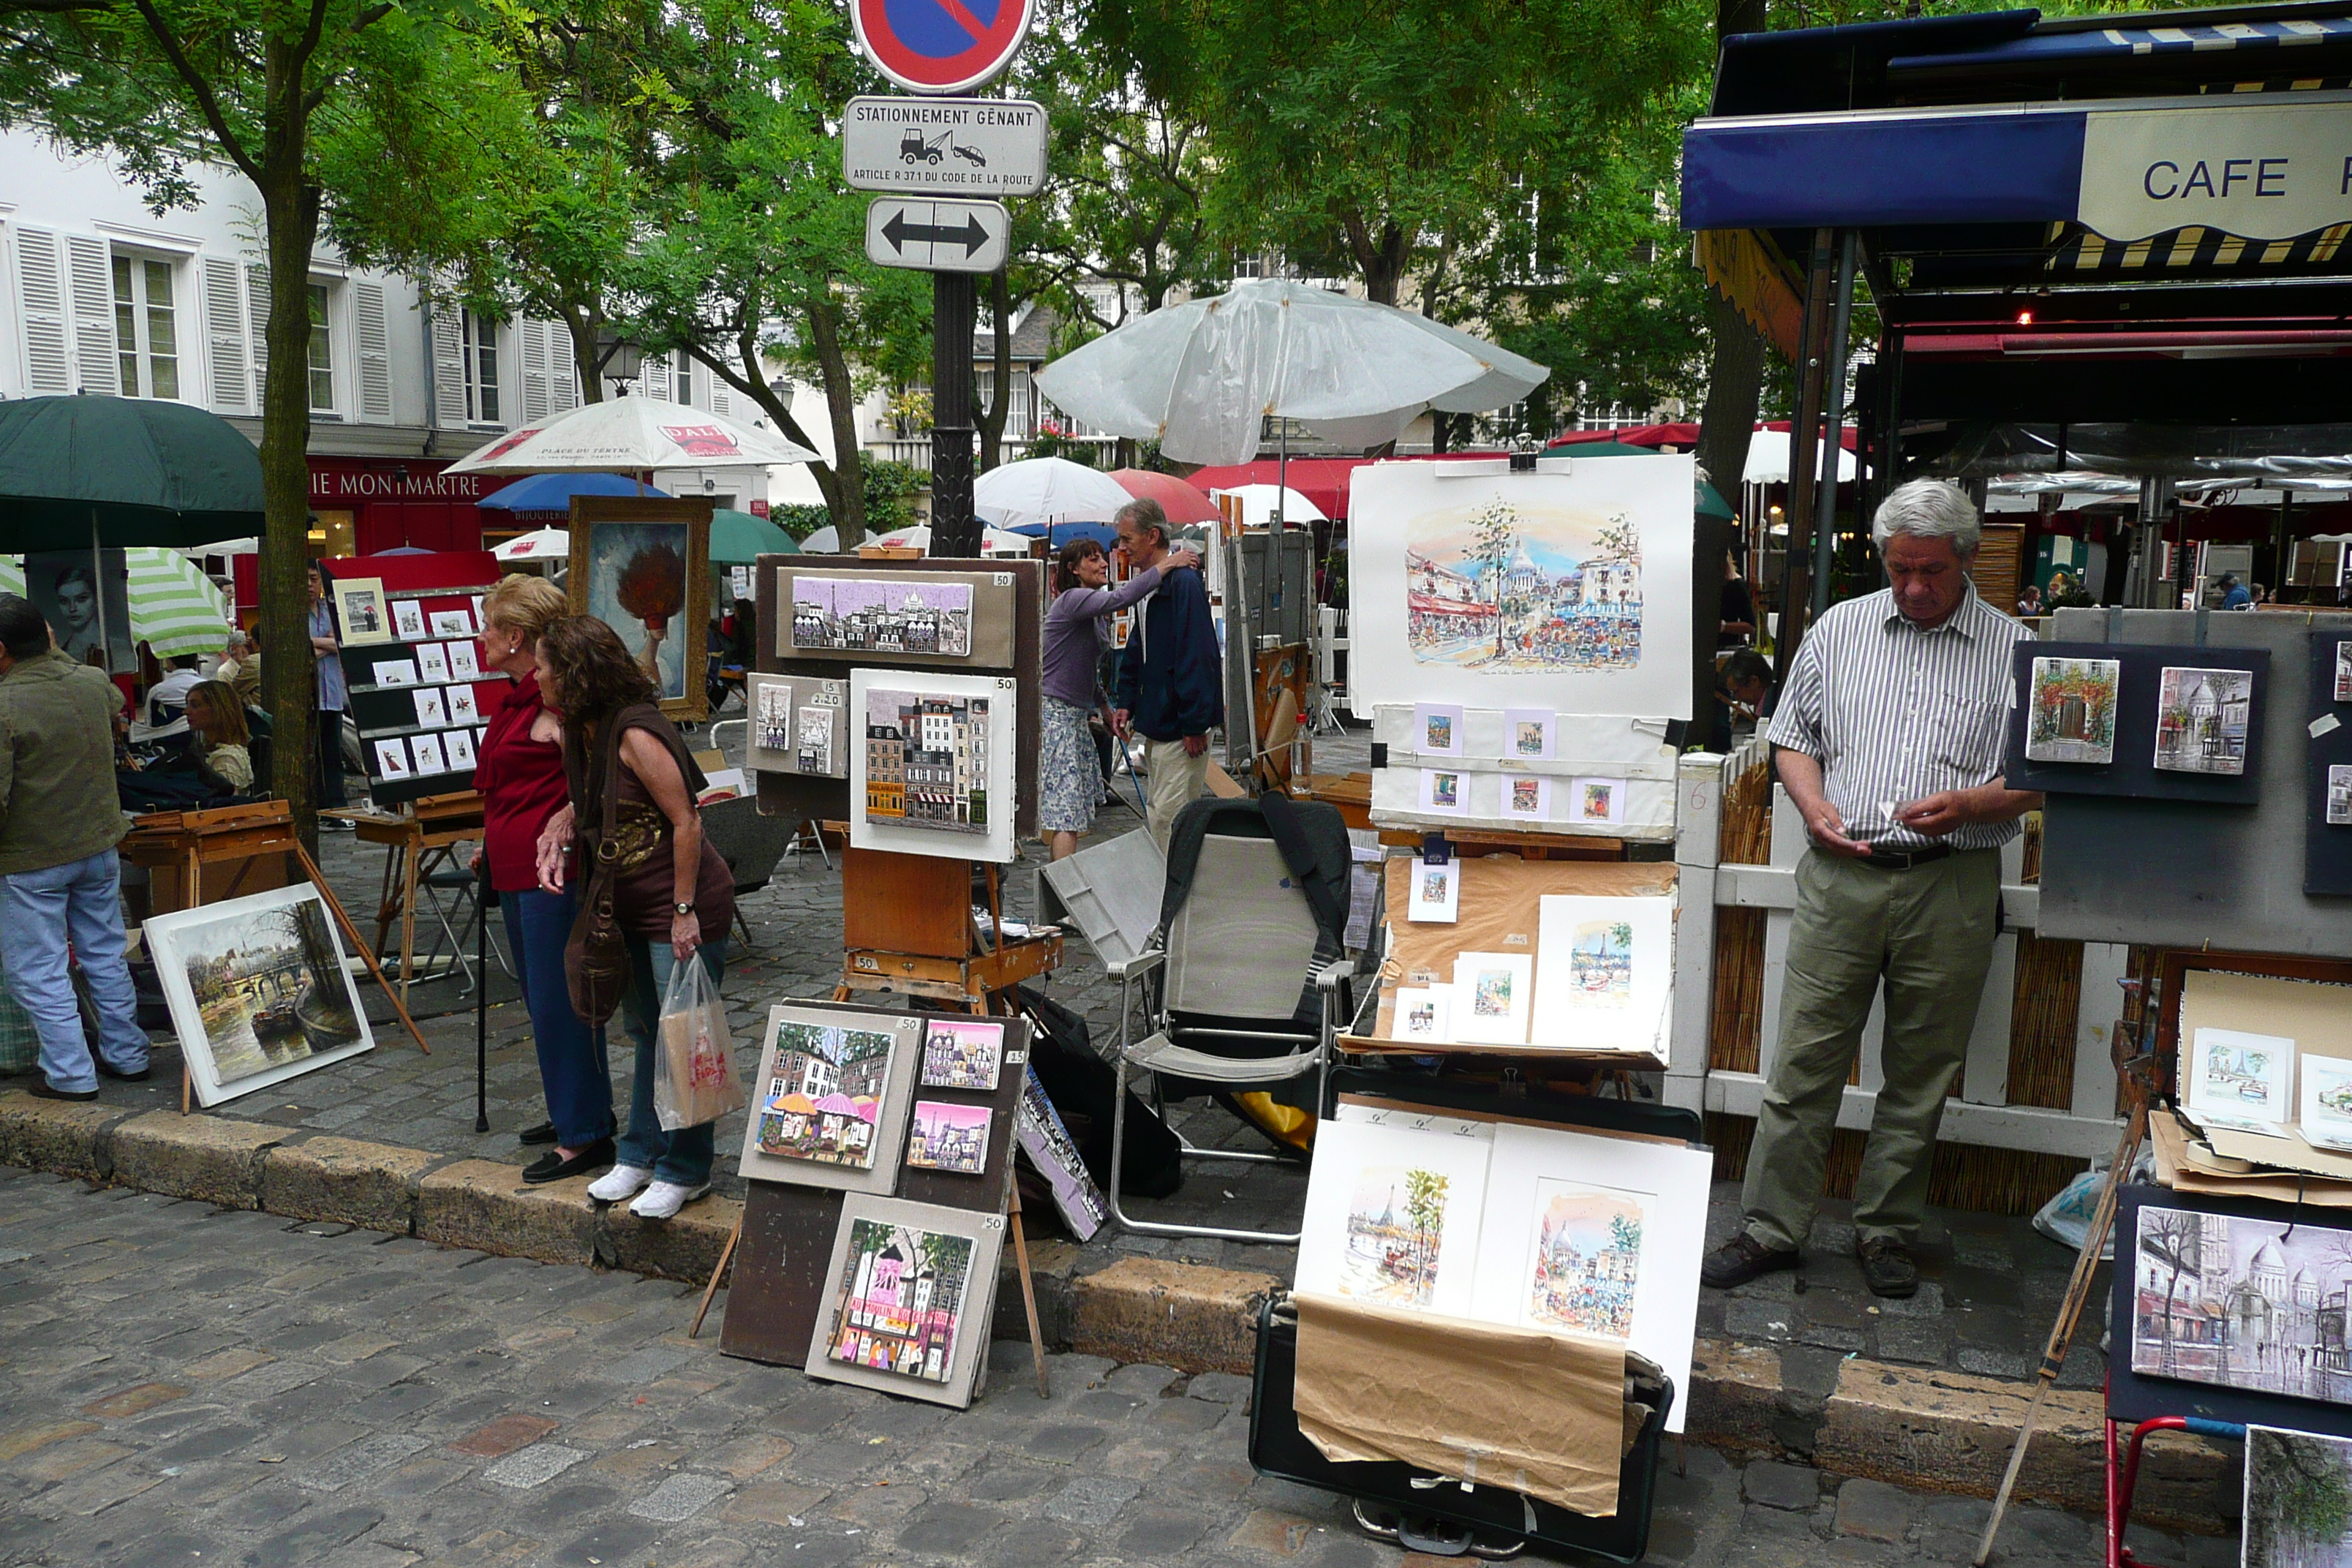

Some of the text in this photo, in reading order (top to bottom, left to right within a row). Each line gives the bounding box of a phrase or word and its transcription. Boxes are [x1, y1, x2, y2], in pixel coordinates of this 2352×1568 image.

[856, 107, 1033, 127] STATIONNEMENT GÊNANT
[853, 169, 891, 181] ARTICLE
[894, 170, 901, 181] R
[925, 172, 938, 182] DU
[942, 173, 967, 183] CODE
[970, 174, 983, 184] DE
[987, 175, 999, 184] LA
[1003, 175, 1033, 185] ROUTE
[2144, 158, 2289, 200] CAFE
[998, 576, 1009, 585] 50
[825, 683, 834, 692] 15
[998, 679, 1012, 690] 50
[1690, 781, 1707, 810] 6
[902, 1019, 916, 1030] 50
[986, 1217, 1001, 1229] 50
